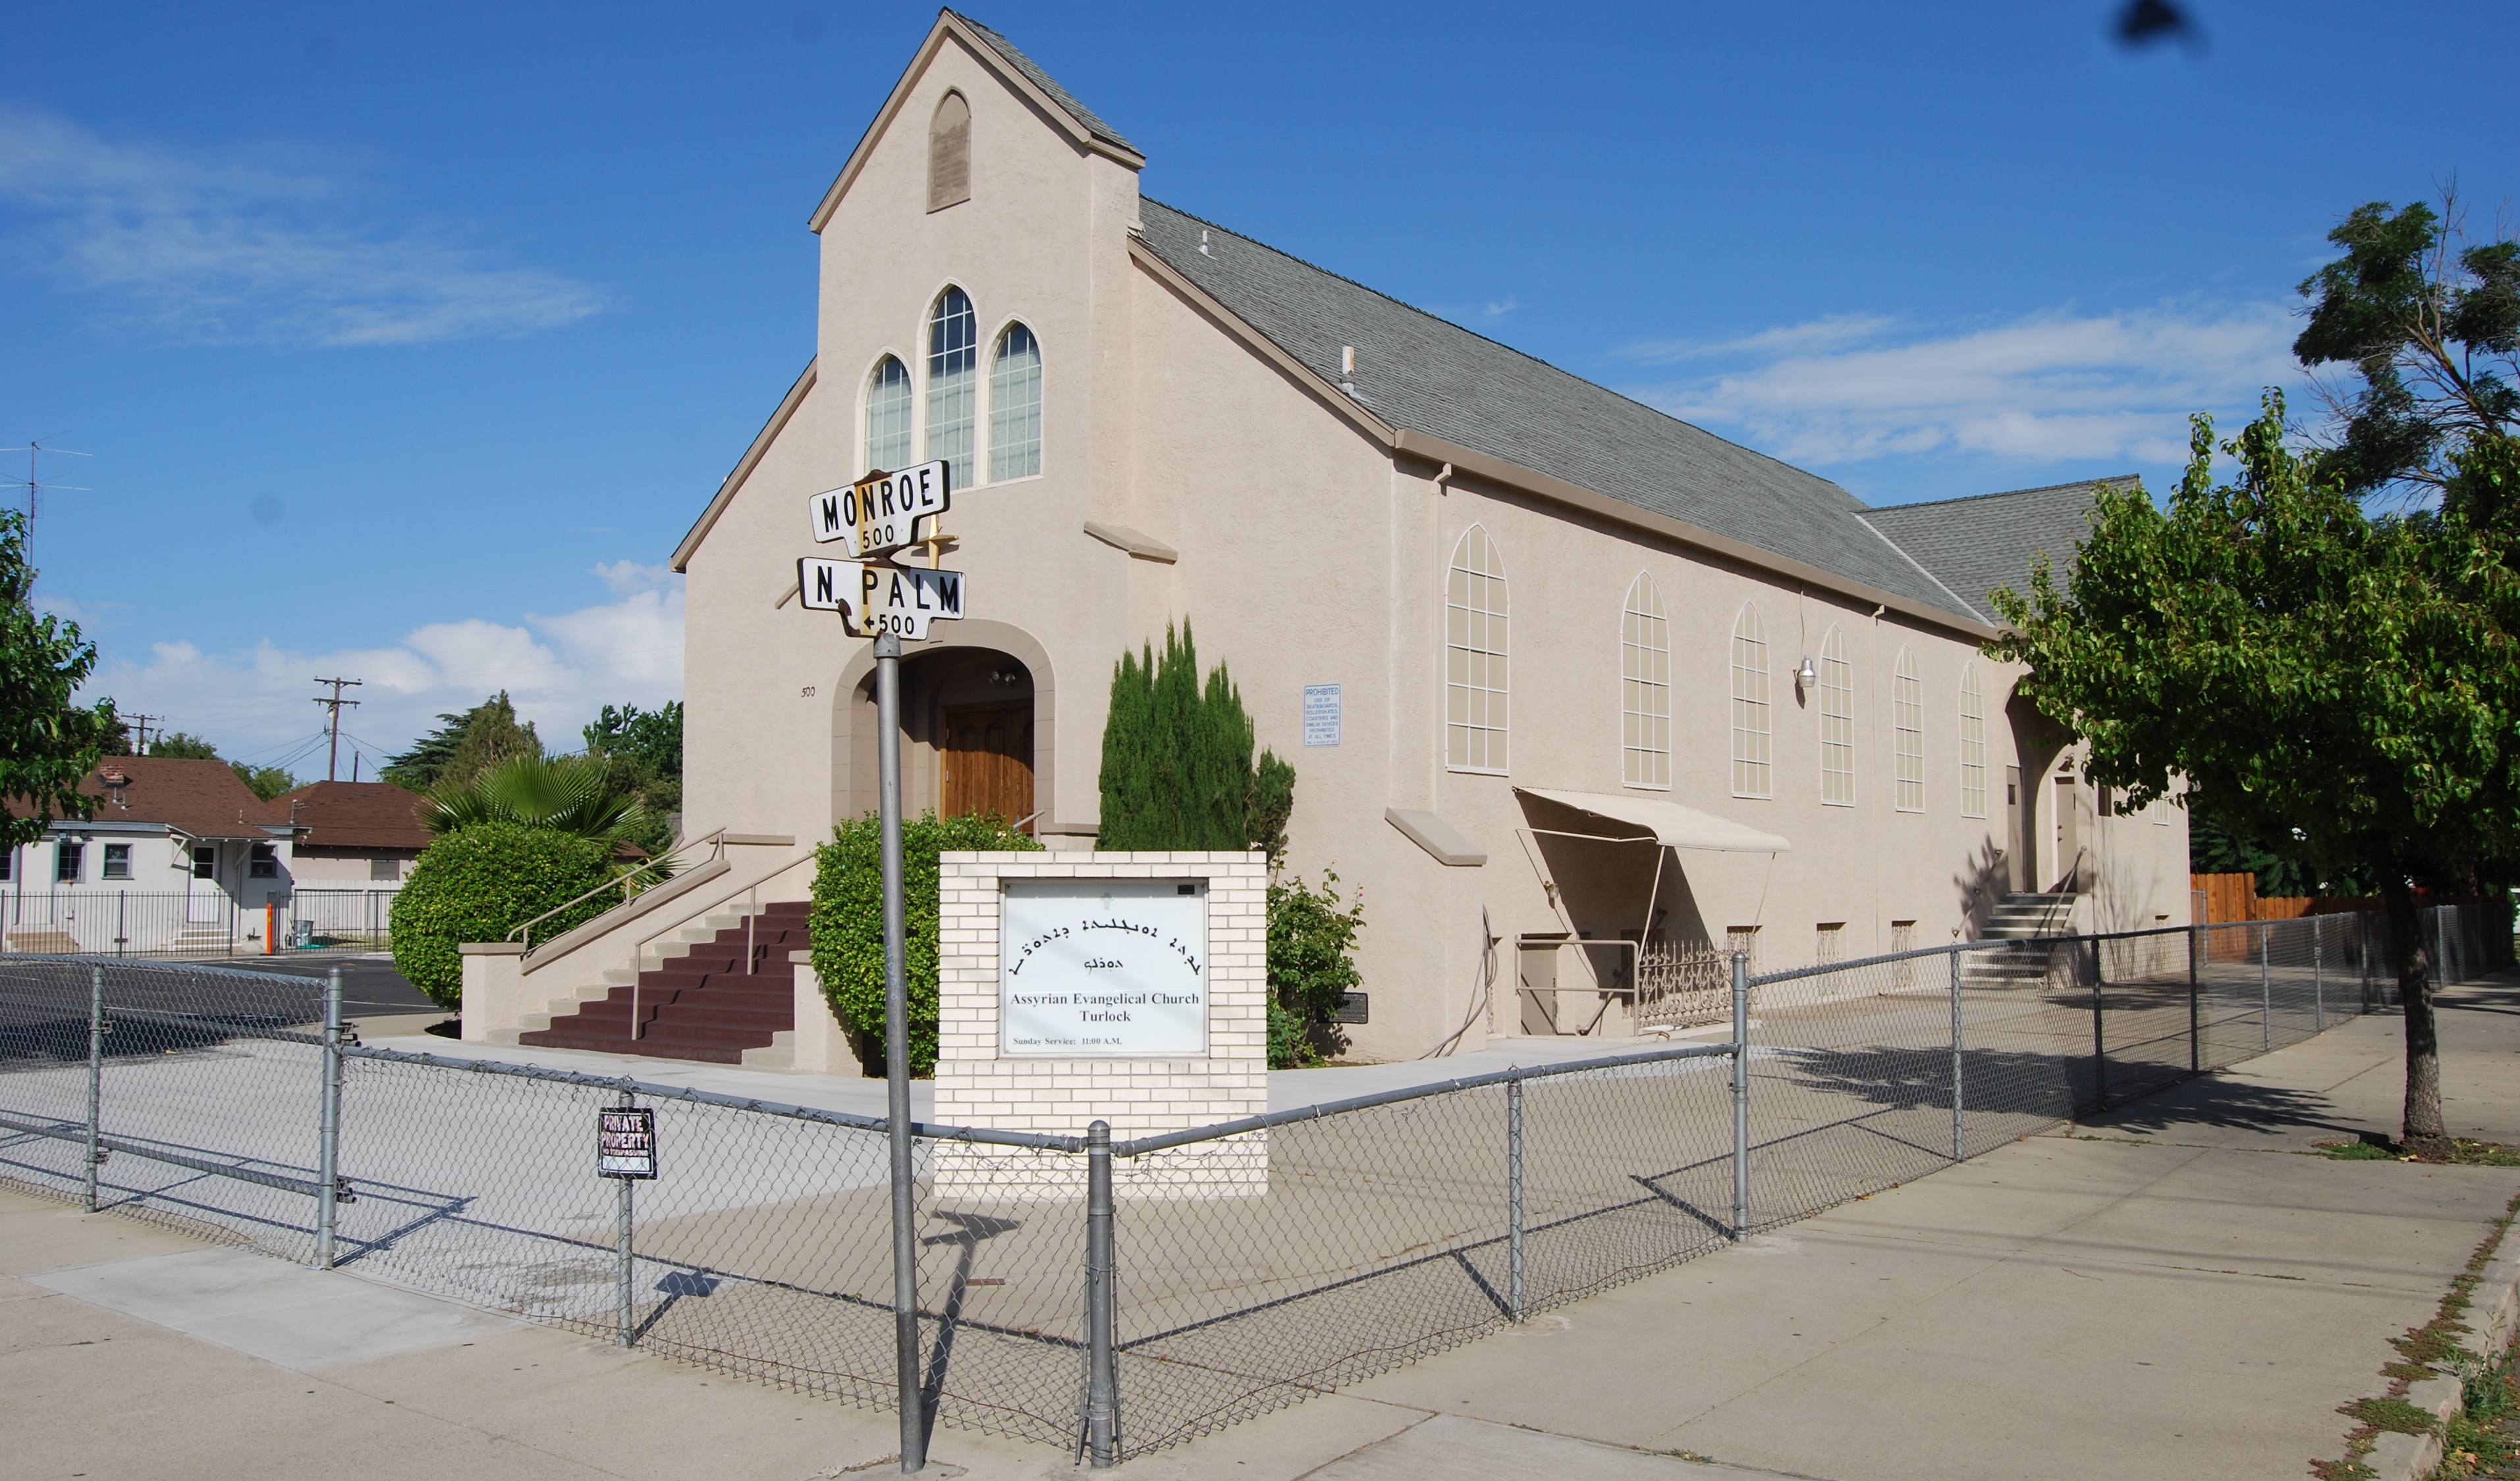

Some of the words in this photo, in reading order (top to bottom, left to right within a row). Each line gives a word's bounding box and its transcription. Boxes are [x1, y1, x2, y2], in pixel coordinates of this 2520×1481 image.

[822, 468, 933, 533] MONROE
[863, 524, 894, 549] 500
[862, 569, 958, 612] PALM
[879, 614, 914, 635] 500
[801, 686, 815, 698] 500
[1306, 687, 1339, 696] PROHIBITED
[1010, 993, 1068, 1008] Assyrian
[1073, 993, 1146, 1008] Evangelical
[1151, 992, 1199, 1004] Church
[1080, 1010, 1132, 1022] Turlock
[1013, 1038, 1042, 1046] Sunday
[604, 1115, 644, 1132] PRIVATE
[601, 1131, 649, 1149] PROPERTY
